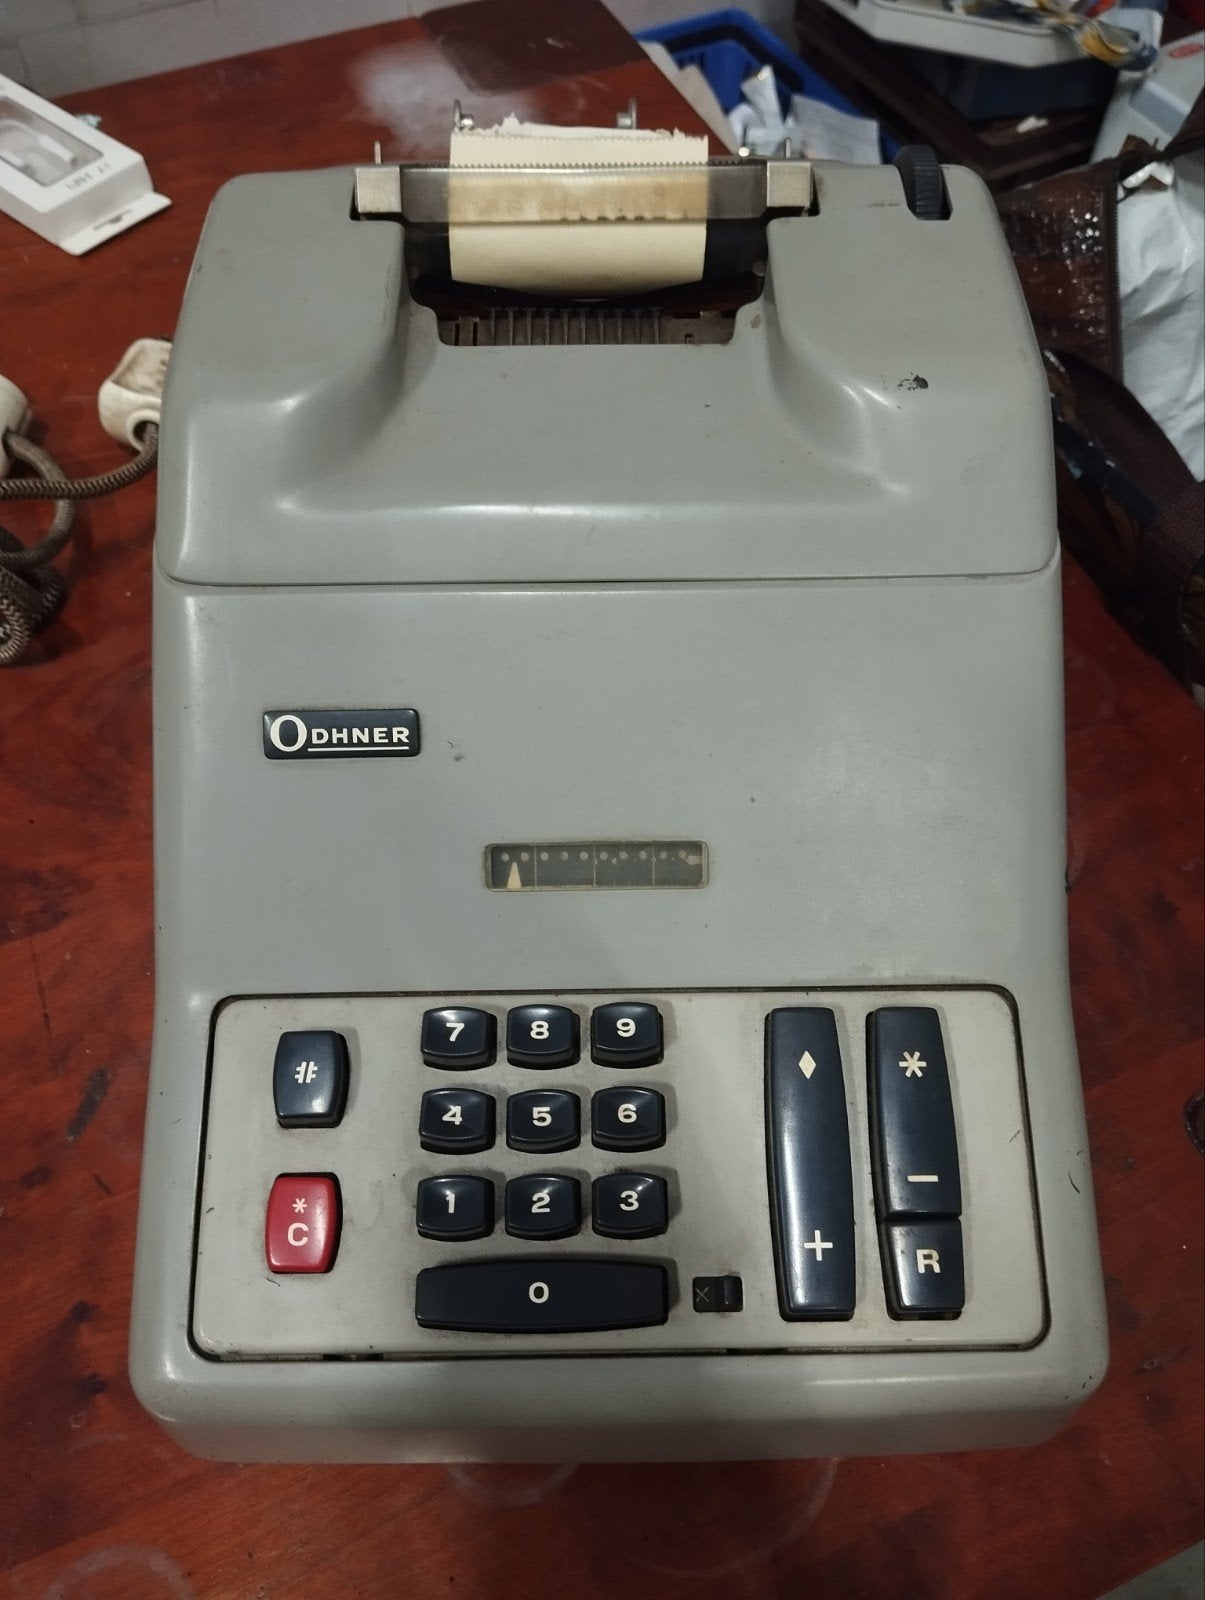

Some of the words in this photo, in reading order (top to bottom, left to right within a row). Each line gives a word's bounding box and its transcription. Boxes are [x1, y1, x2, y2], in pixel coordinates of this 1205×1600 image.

[270, 714, 410, 752] ODHNER
[446, 1022, 465, 1042] 7
[530, 1020, 550, 1040] 8
[617, 1018, 637, 1037] 9
[442, 1106, 463, 1126] 4
[532, 1106, 552, 1127] 5
[617, 1103, 638, 1123] 6
[446, 1193, 456, 1214] 1
[531, 1192, 551, 1213] 2
[620, 1190, 639, 1211] 3
[287, 1222, 309, 1246] C
[916, 1248, 941, 1274] R
